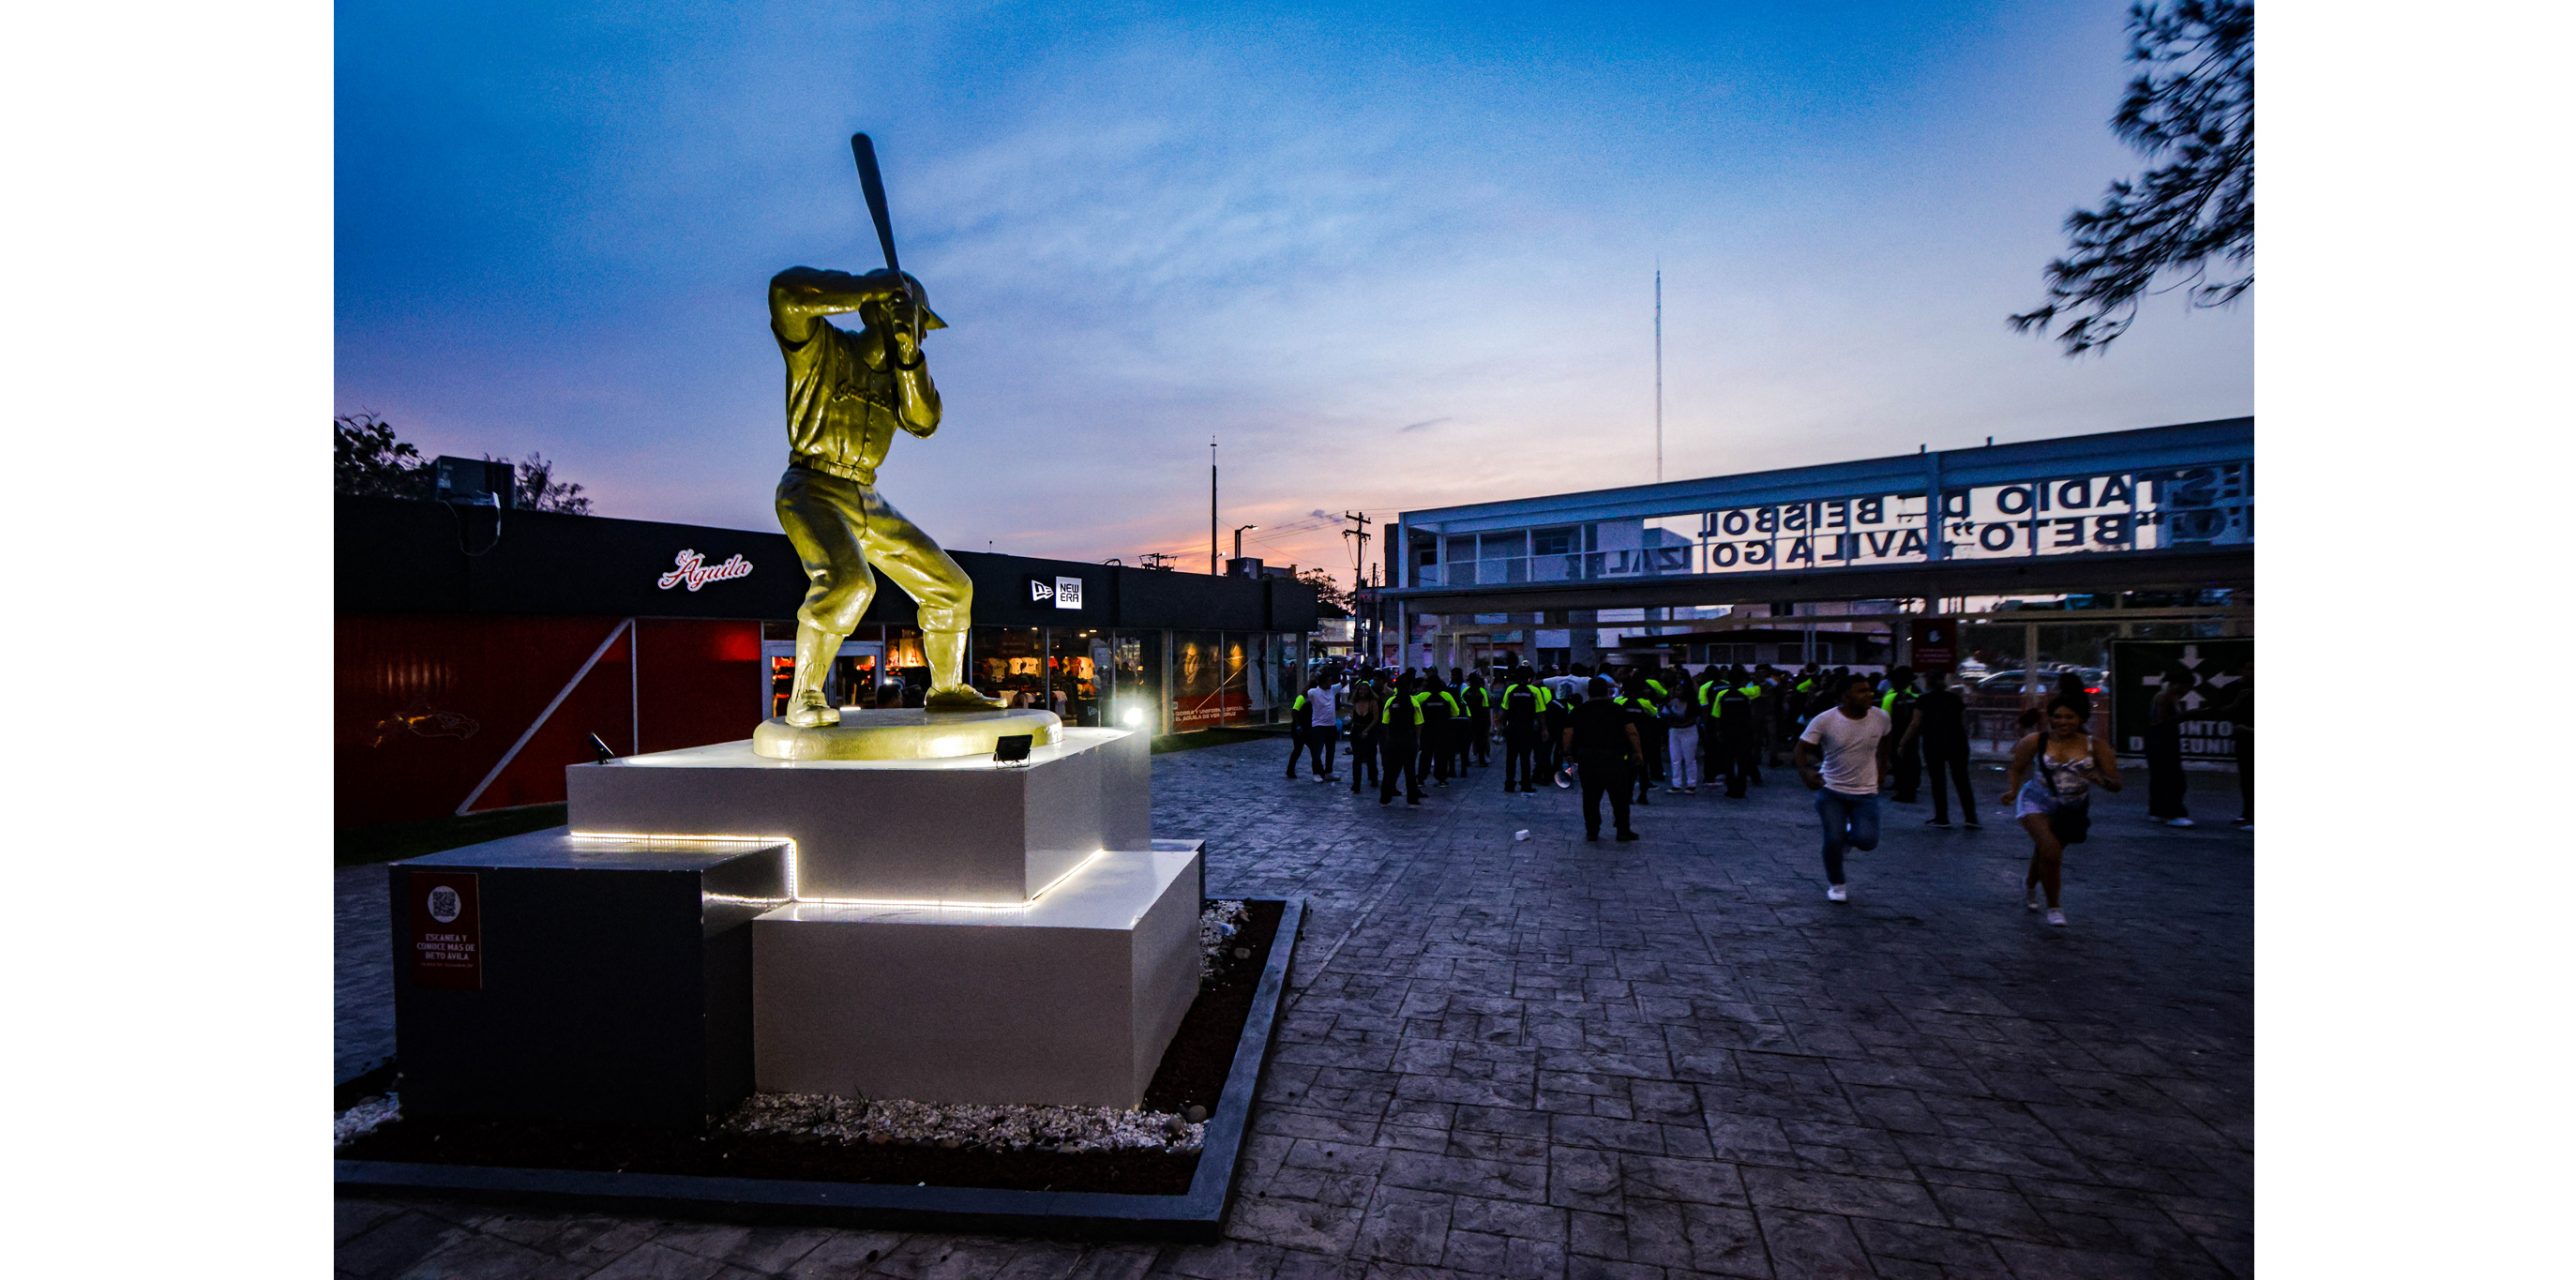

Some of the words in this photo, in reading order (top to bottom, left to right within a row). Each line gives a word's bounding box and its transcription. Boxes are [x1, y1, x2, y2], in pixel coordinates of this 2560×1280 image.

[1060, 583, 1079, 593] NEW
[1060, 592, 1079, 602] ERA
[425, 933, 460, 942] ESCANEA
[416, 942, 446, 951] CONOCE
[425, 951, 446, 960] BETO
